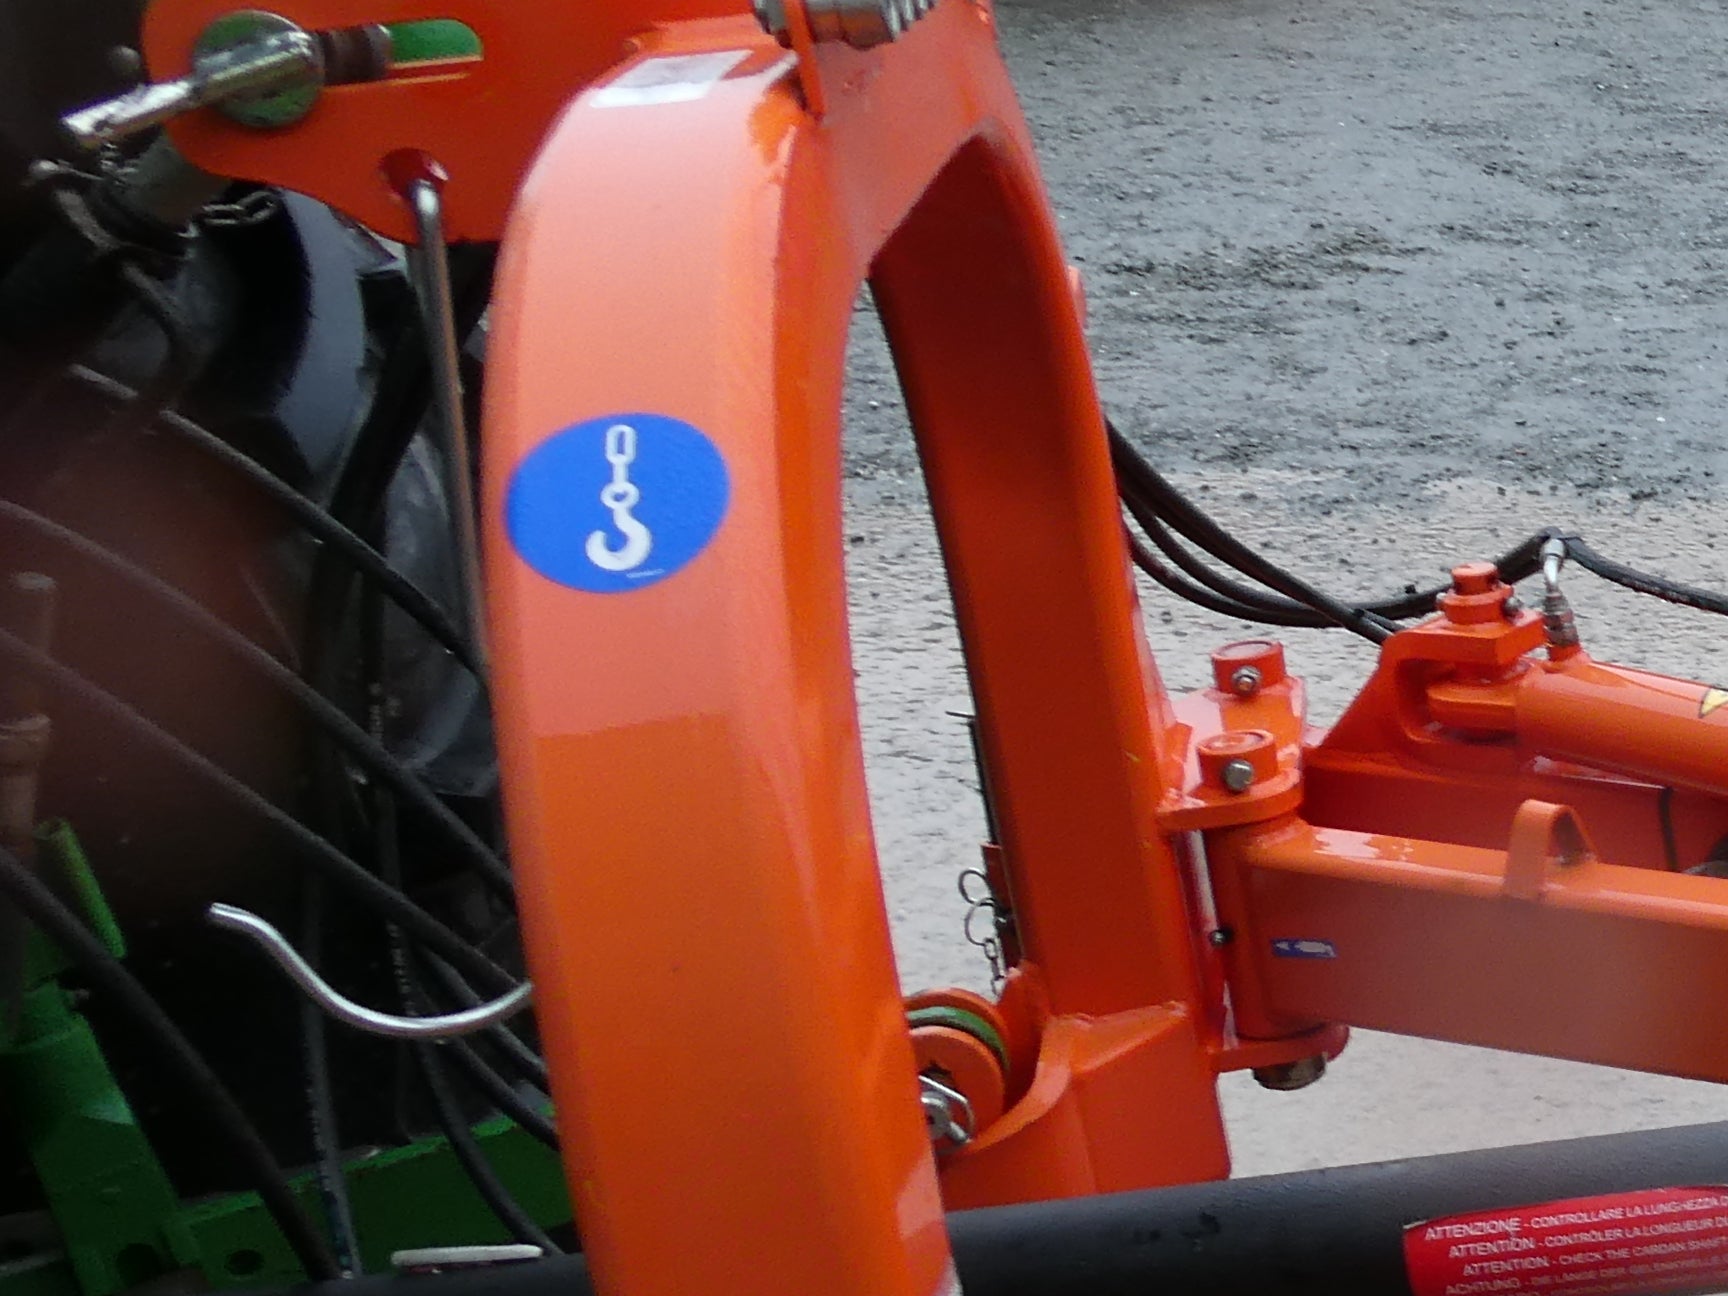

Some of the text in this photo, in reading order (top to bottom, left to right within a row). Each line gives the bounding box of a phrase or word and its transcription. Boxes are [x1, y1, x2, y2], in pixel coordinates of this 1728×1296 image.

[1424, 1217, 1521, 1241] ATTENZIONE
[1530, 1206, 1624, 1229] CONTROLLARE
[1448, 1237, 1535, 1258] ATTENTION
[1463, 1256, 1549, 1276] ATTENTION
